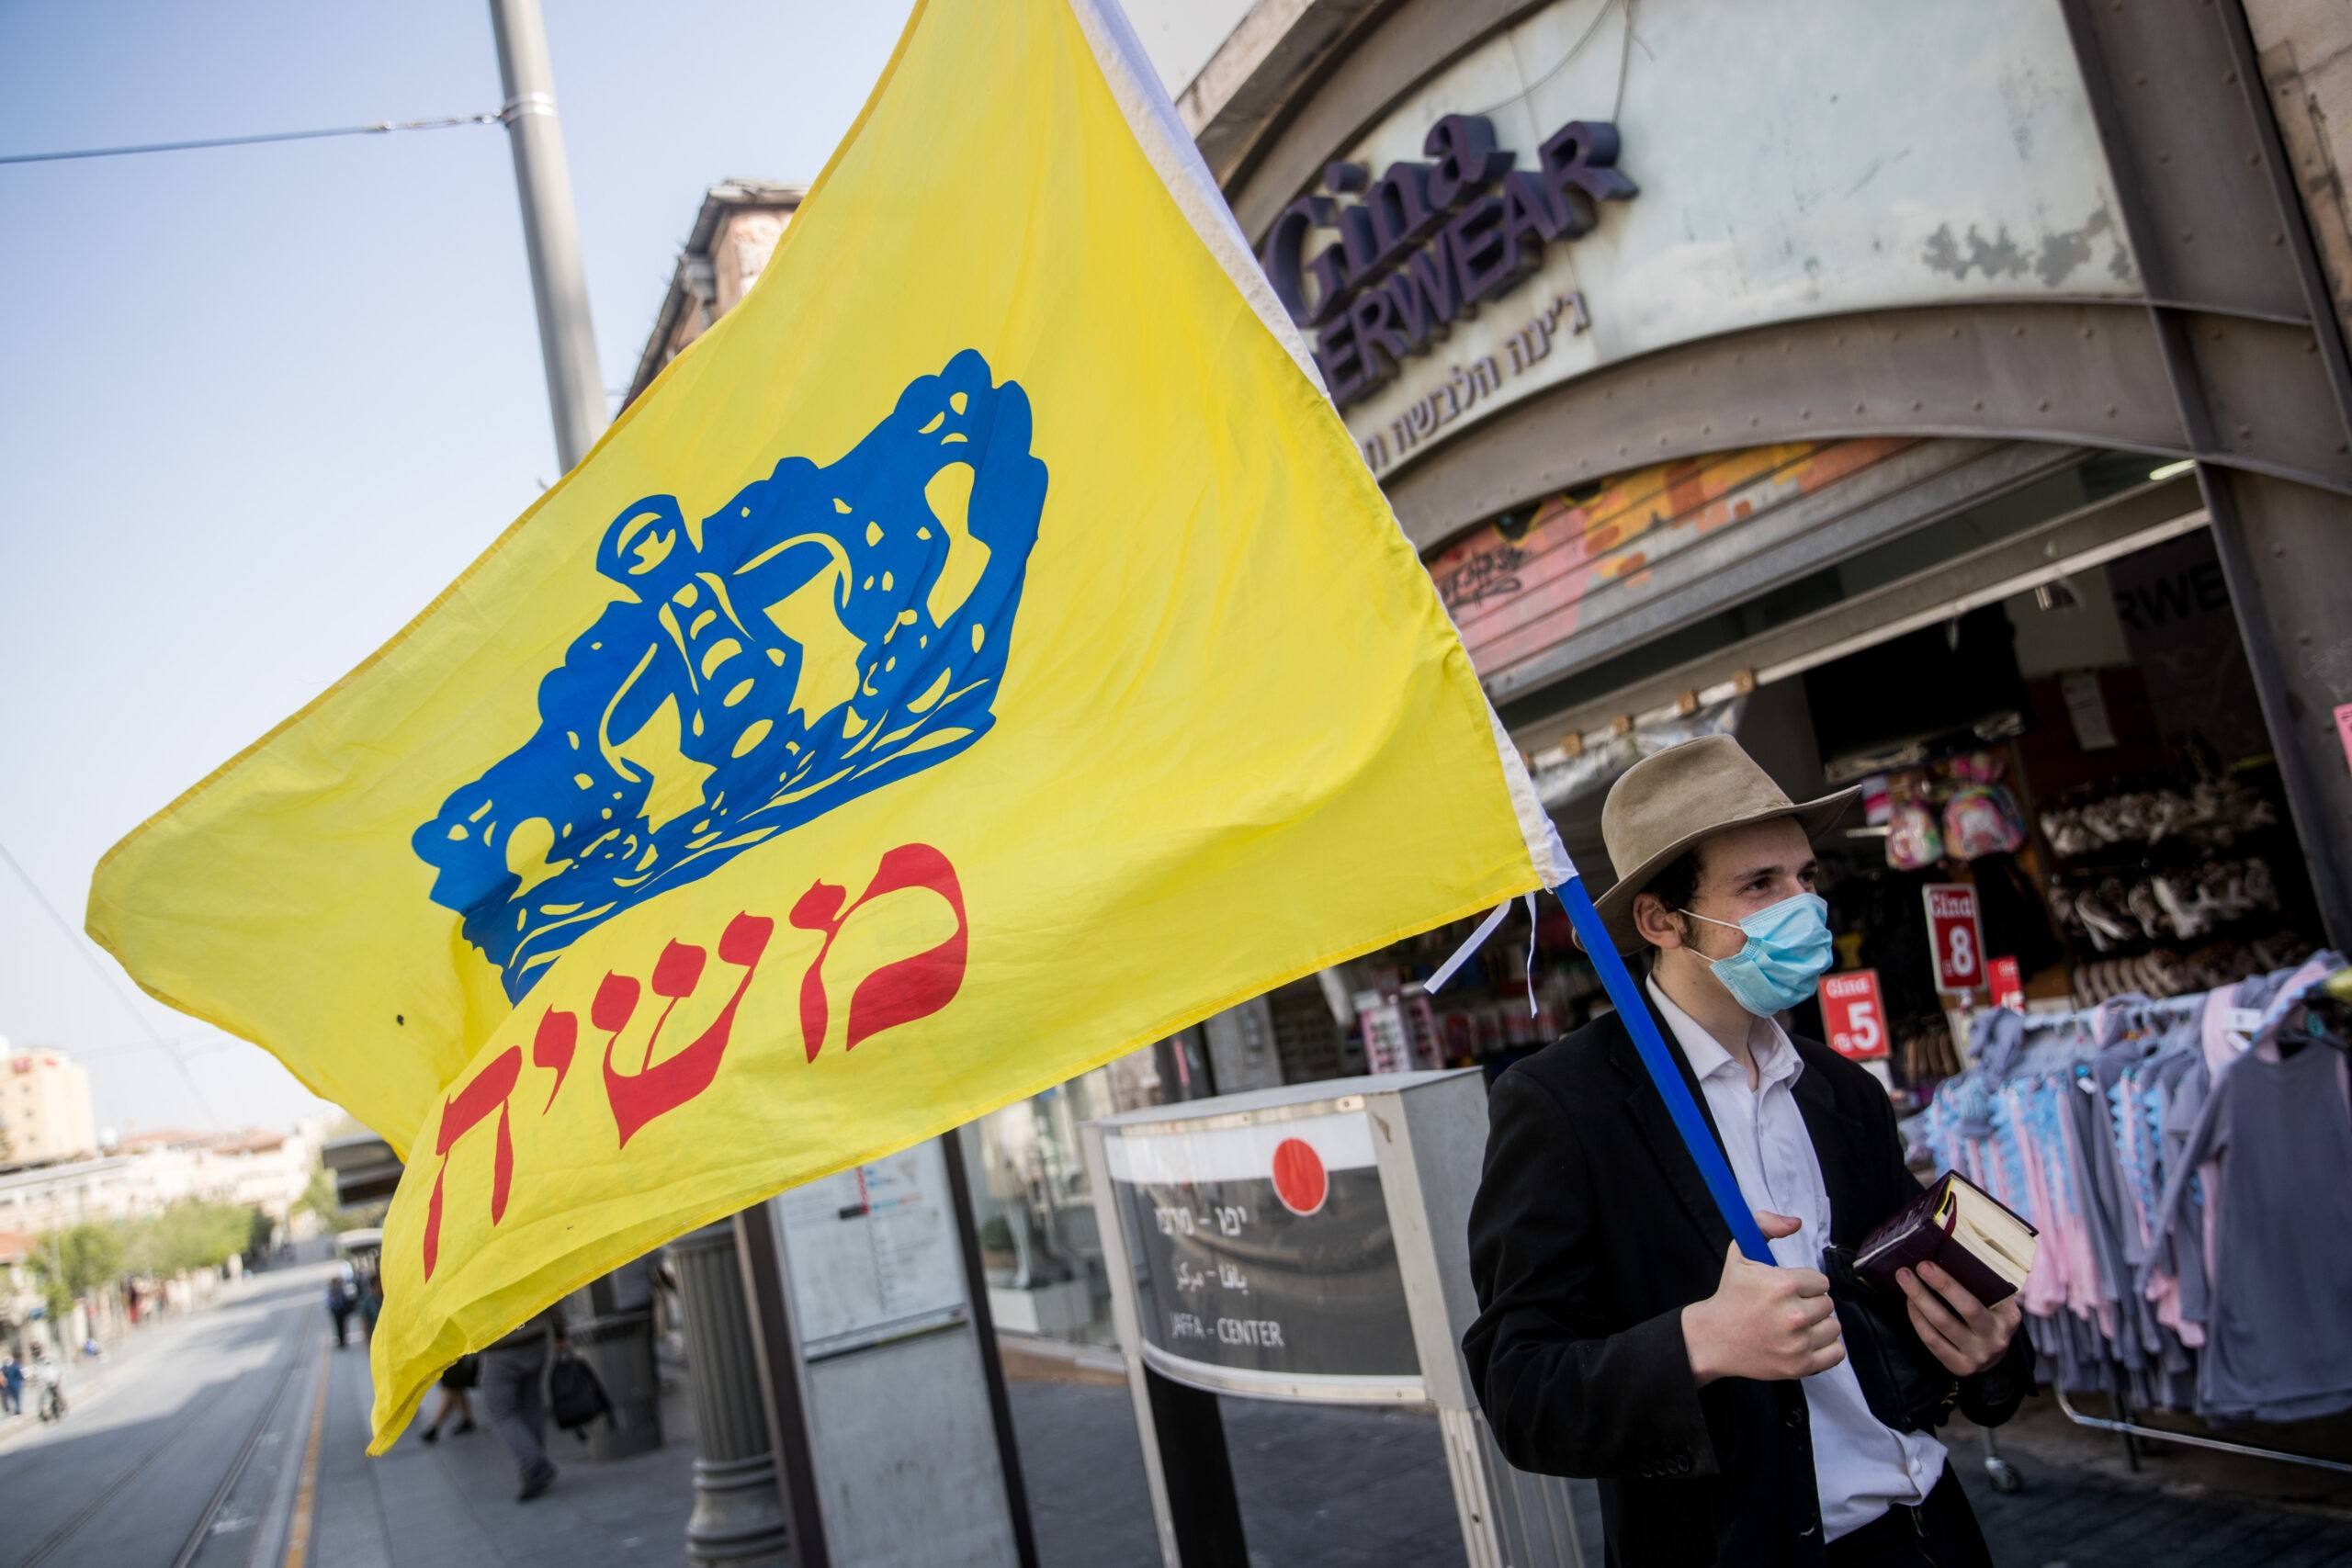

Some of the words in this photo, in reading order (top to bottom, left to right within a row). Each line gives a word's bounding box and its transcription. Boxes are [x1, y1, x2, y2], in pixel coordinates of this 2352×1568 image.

[1264, 114, 1516, 327] Gina
[1311, 120, 1640, 406] ERWEAR
[1391, 355, 1502, 455] הלבשה
[1826, 976, 1870, 999] Gina
[424, 842, 968, 1284] משיח
[1215, 1205, 1248, 1236] יפו
[1216, 1317, 1285, 1348] CENTER
